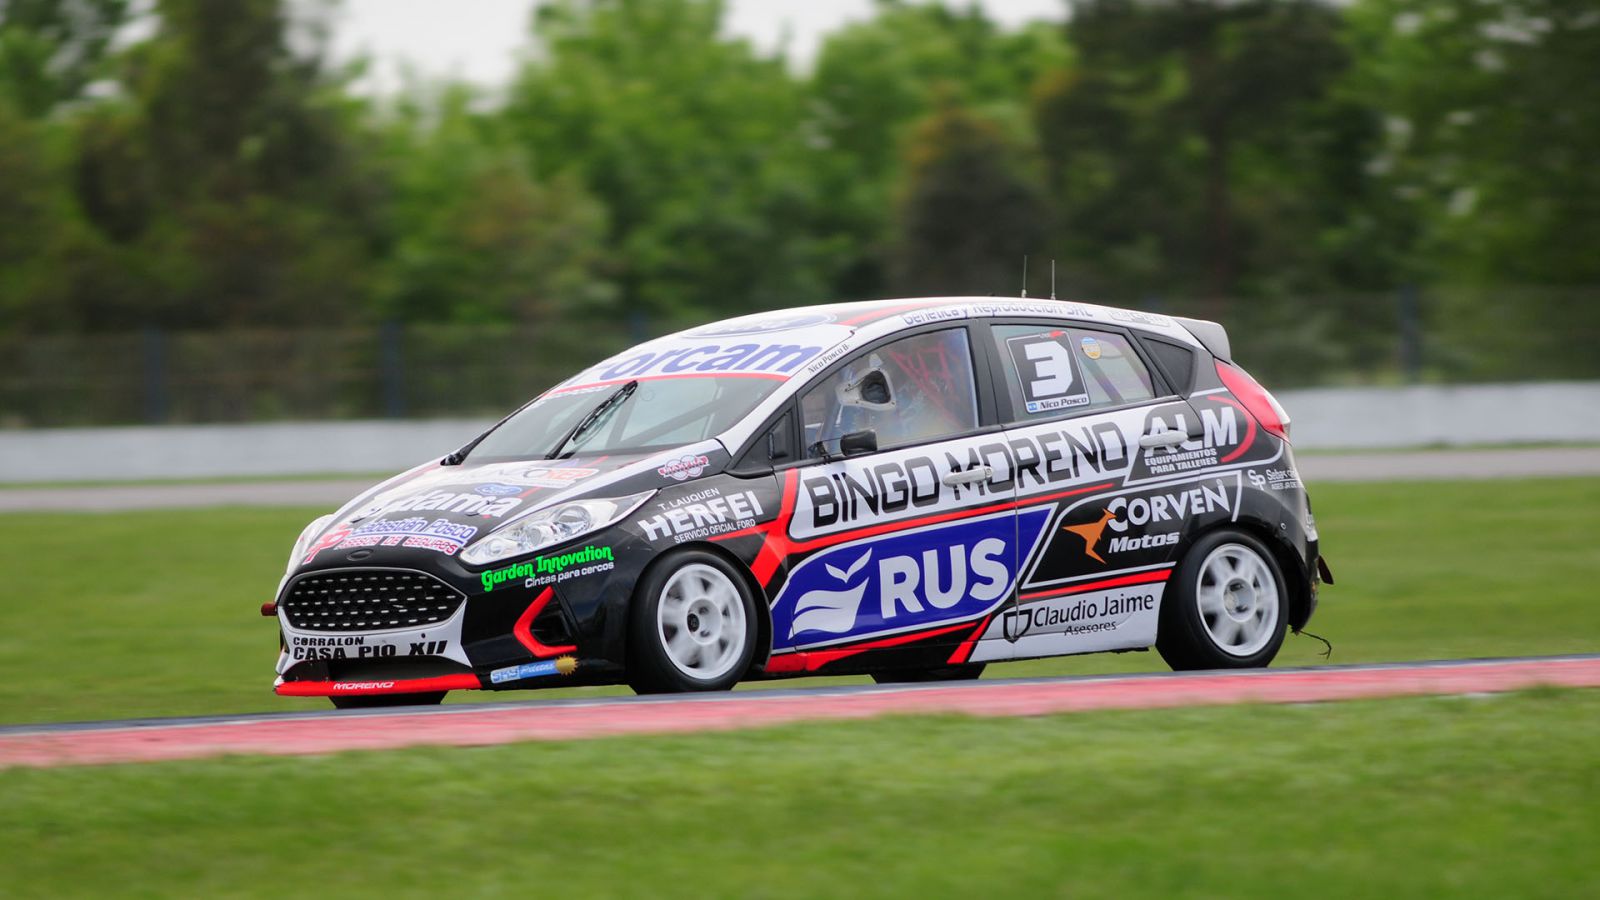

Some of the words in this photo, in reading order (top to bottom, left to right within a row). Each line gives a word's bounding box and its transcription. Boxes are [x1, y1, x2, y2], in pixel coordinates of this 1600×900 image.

[808, 362, 824, 373] Nico
[823, 348, 844, 364] Posco
[1024, 341, 1073, 398] 3
[1040, 400, 1059, 409] Nico
[1061, 397, 1087, 407] Posco
[1144, 406, 1237, 457] ALM
[1144, 448, 1217, 466] EQUIPAMIENTOS
[1150, 464, 1175, 474] PARA
[1176, 457, 1217, 470] TALLERES
[803, 456, 939, 528] BINGO
[945, 422, 1128, 500] MORENO
[670, 487, 720, 508] LAUQUEN
[1107, 478, 1230, 532] CORVEN
[637, 490, 764, 541] HERFEI
[383, 535, 400, 546] DE
[430, 518, 477, 540] Posco
[673, 529, 709, 544] SERVICIO
[710, 522, 736, 533] OFICIAL
[736, 518, 756, 529] FORD
[1108, 532, 1180, 553] Motos
[481, 563, 535, 592] Garden
[535, 546, 614, 573] Innovation
[525, 574, 557, 588] Cintas
[558, 569, 580, 583] para
[581, 562, 614, 576] cercos
[879, 538, 1009, 618] RUS
[1034, 599, 1097, 627] Claudio
[1100, 593, 1154, 617] Jaime
[1064, 621, 1117, 636] Asesores
[293, 636, 364, 646] CORRALON
[293, 647, 346, 660] CASA
[358, 644, 396, 658] PIO
[409, 639, 448, 656] XII
[333, 681, 394, 690] MORENO
